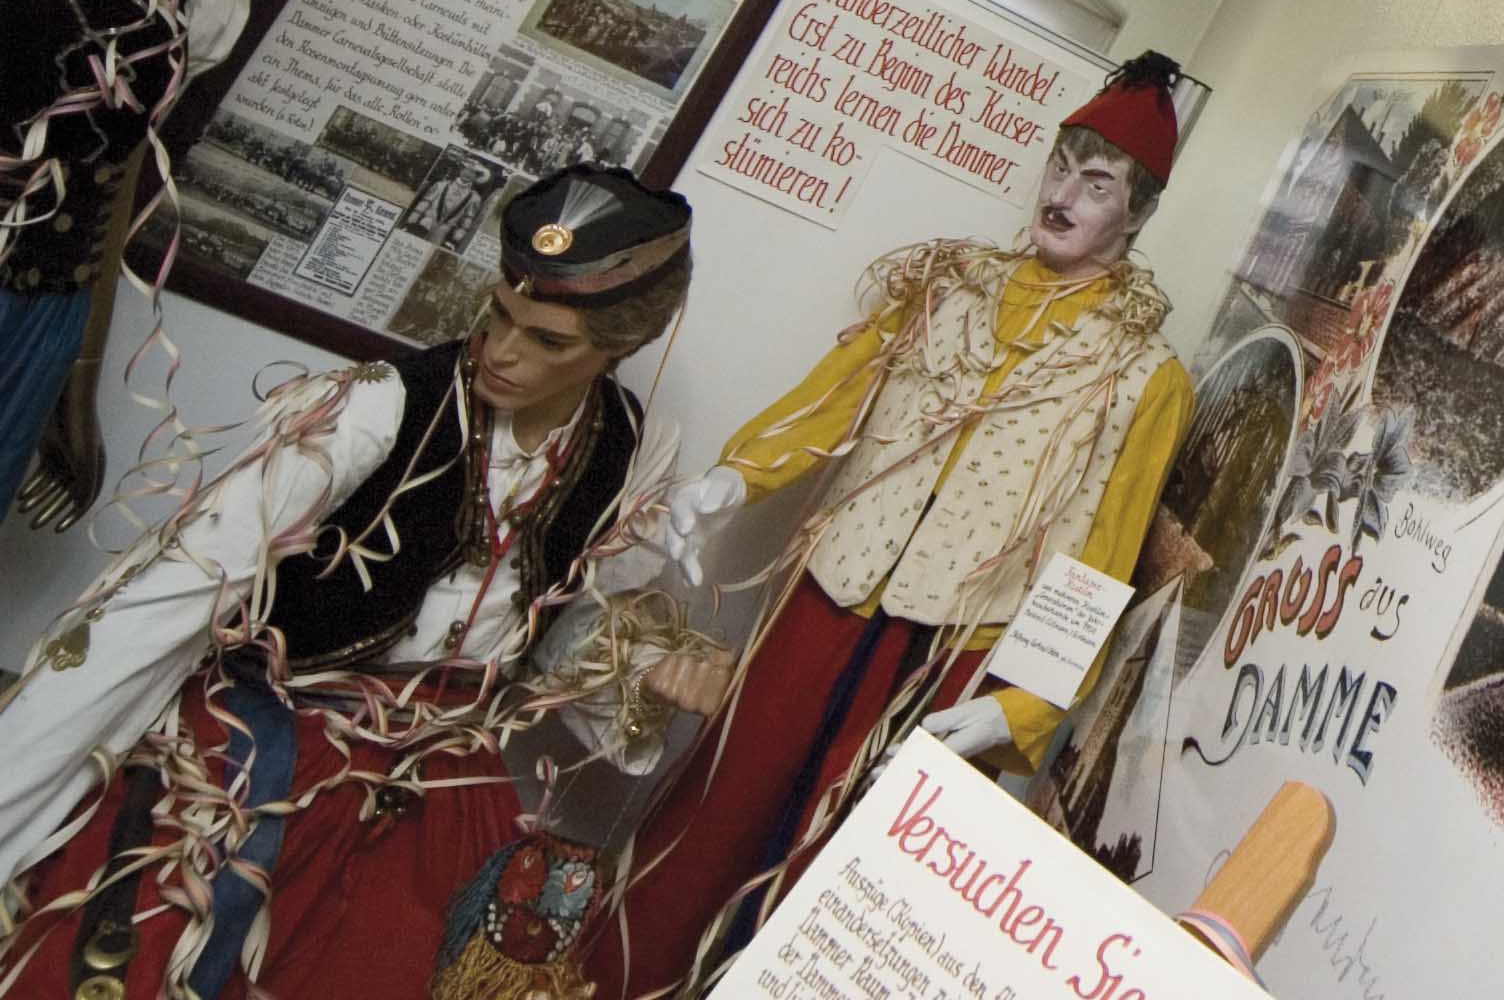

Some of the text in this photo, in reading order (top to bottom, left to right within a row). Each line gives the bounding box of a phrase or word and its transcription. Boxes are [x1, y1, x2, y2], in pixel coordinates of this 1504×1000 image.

[788, 3, 1045, 147] Erst zu Beginn des Kaiser-
[738, 89, 862, 166] sich zu ko-
[765, 52, 1021, 194] reichs lernen die Dammer,
[1394, 502, 1452, 574] Bohlweg
[1360, 578, 1409, 641] aus
[1181, 663, 1398, 787] DAMME
[886, 769, 1066, 972] Versuchen
[778, 932, 802, 965] der
[799, 905, 854, 969] Dammer
[818, 886, 931, 997] einandersetzungen
[840, 856, 987, 1000] Auszüge (Kopien) aus den
[758, 968, 793, 999] und
